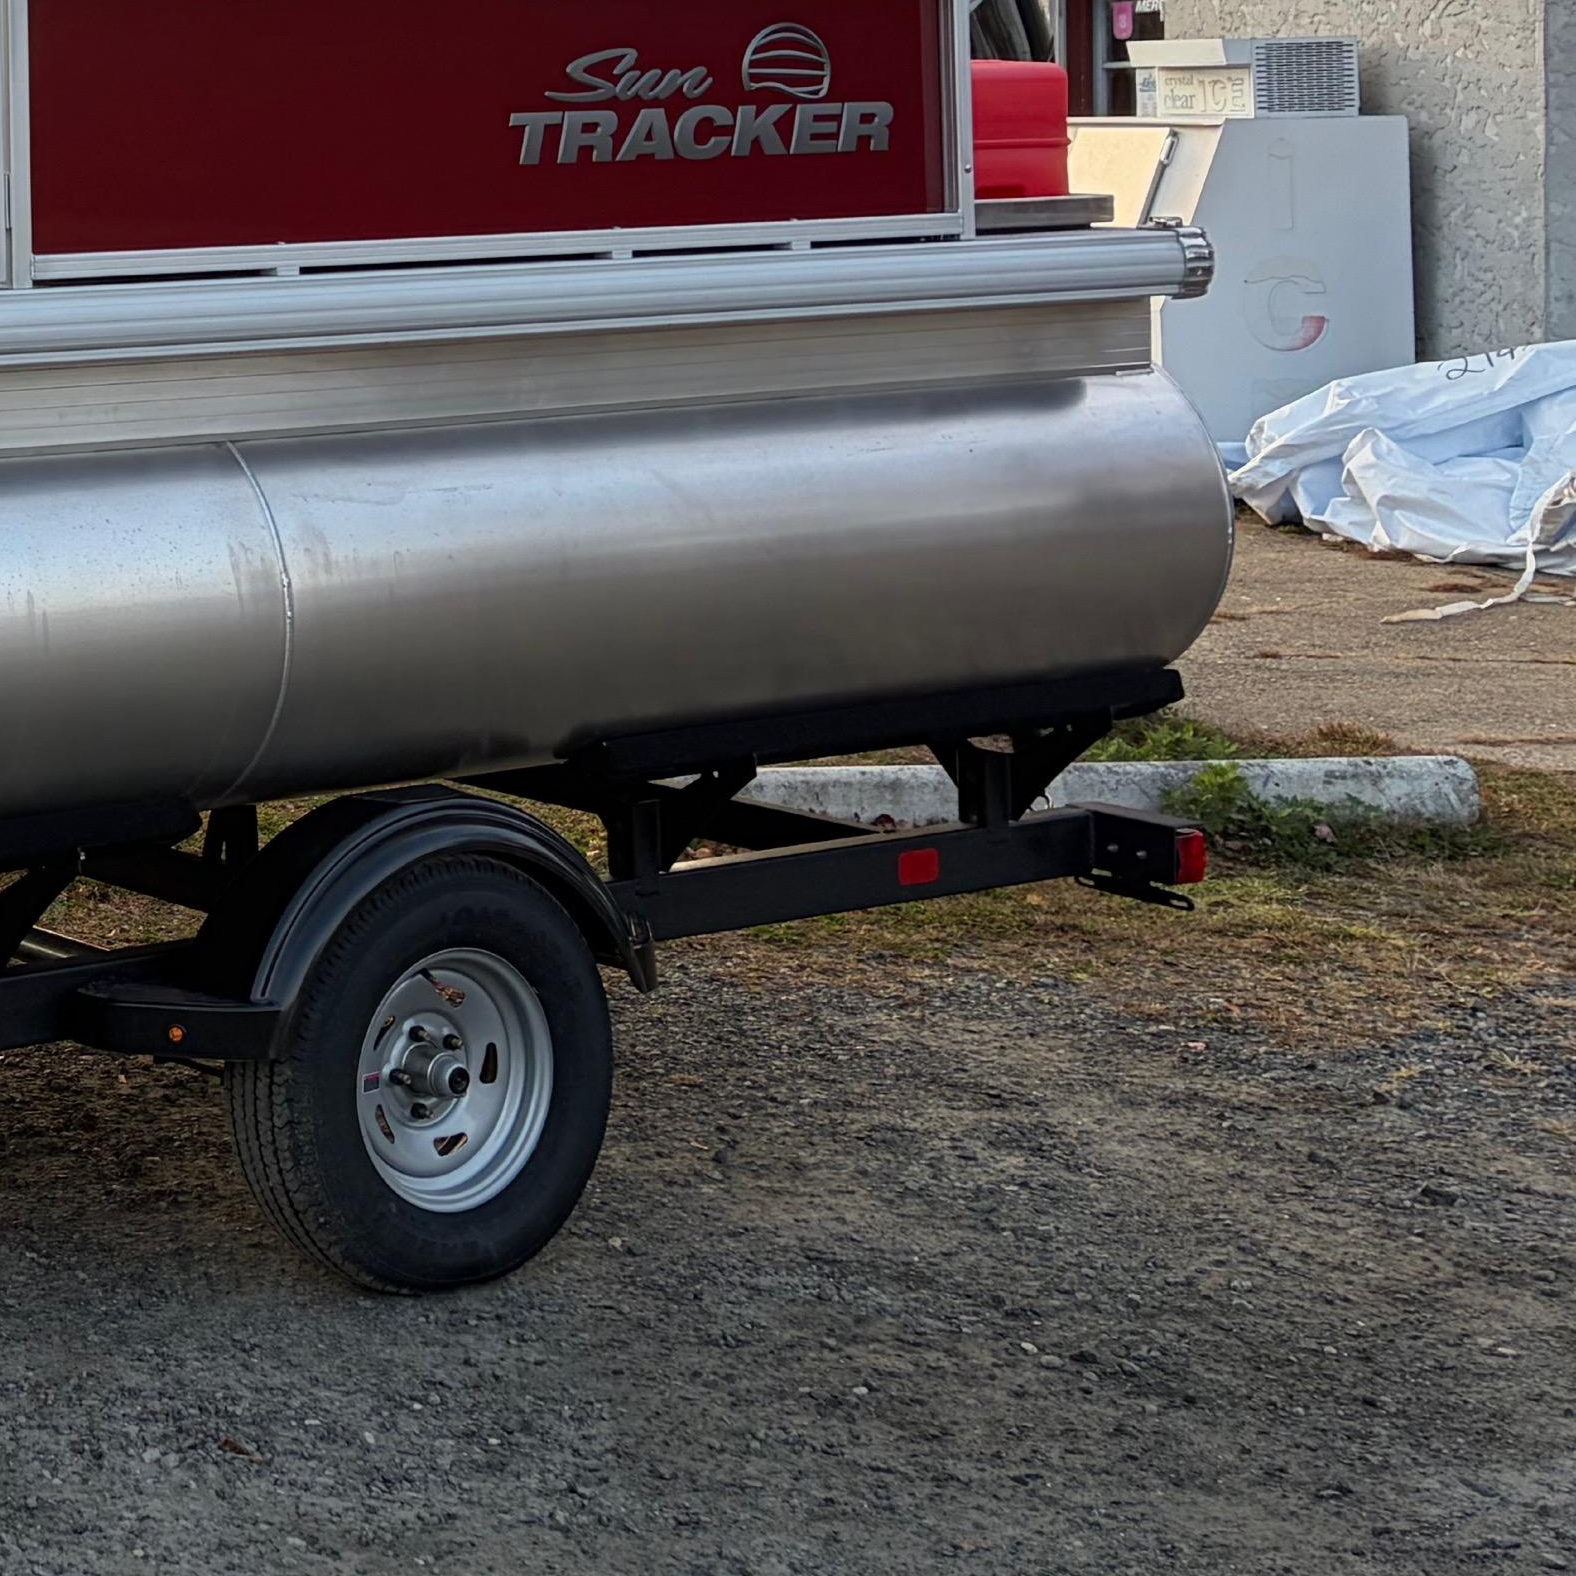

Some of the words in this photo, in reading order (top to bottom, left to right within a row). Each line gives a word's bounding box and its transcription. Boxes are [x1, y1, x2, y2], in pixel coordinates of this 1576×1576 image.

[544, 47, 713, 104] Sun
[1163, 89, 1196, 111] clear
[1198, 75, 1246, 113] ICE
[508, 100, 895, 166] TRACKER
